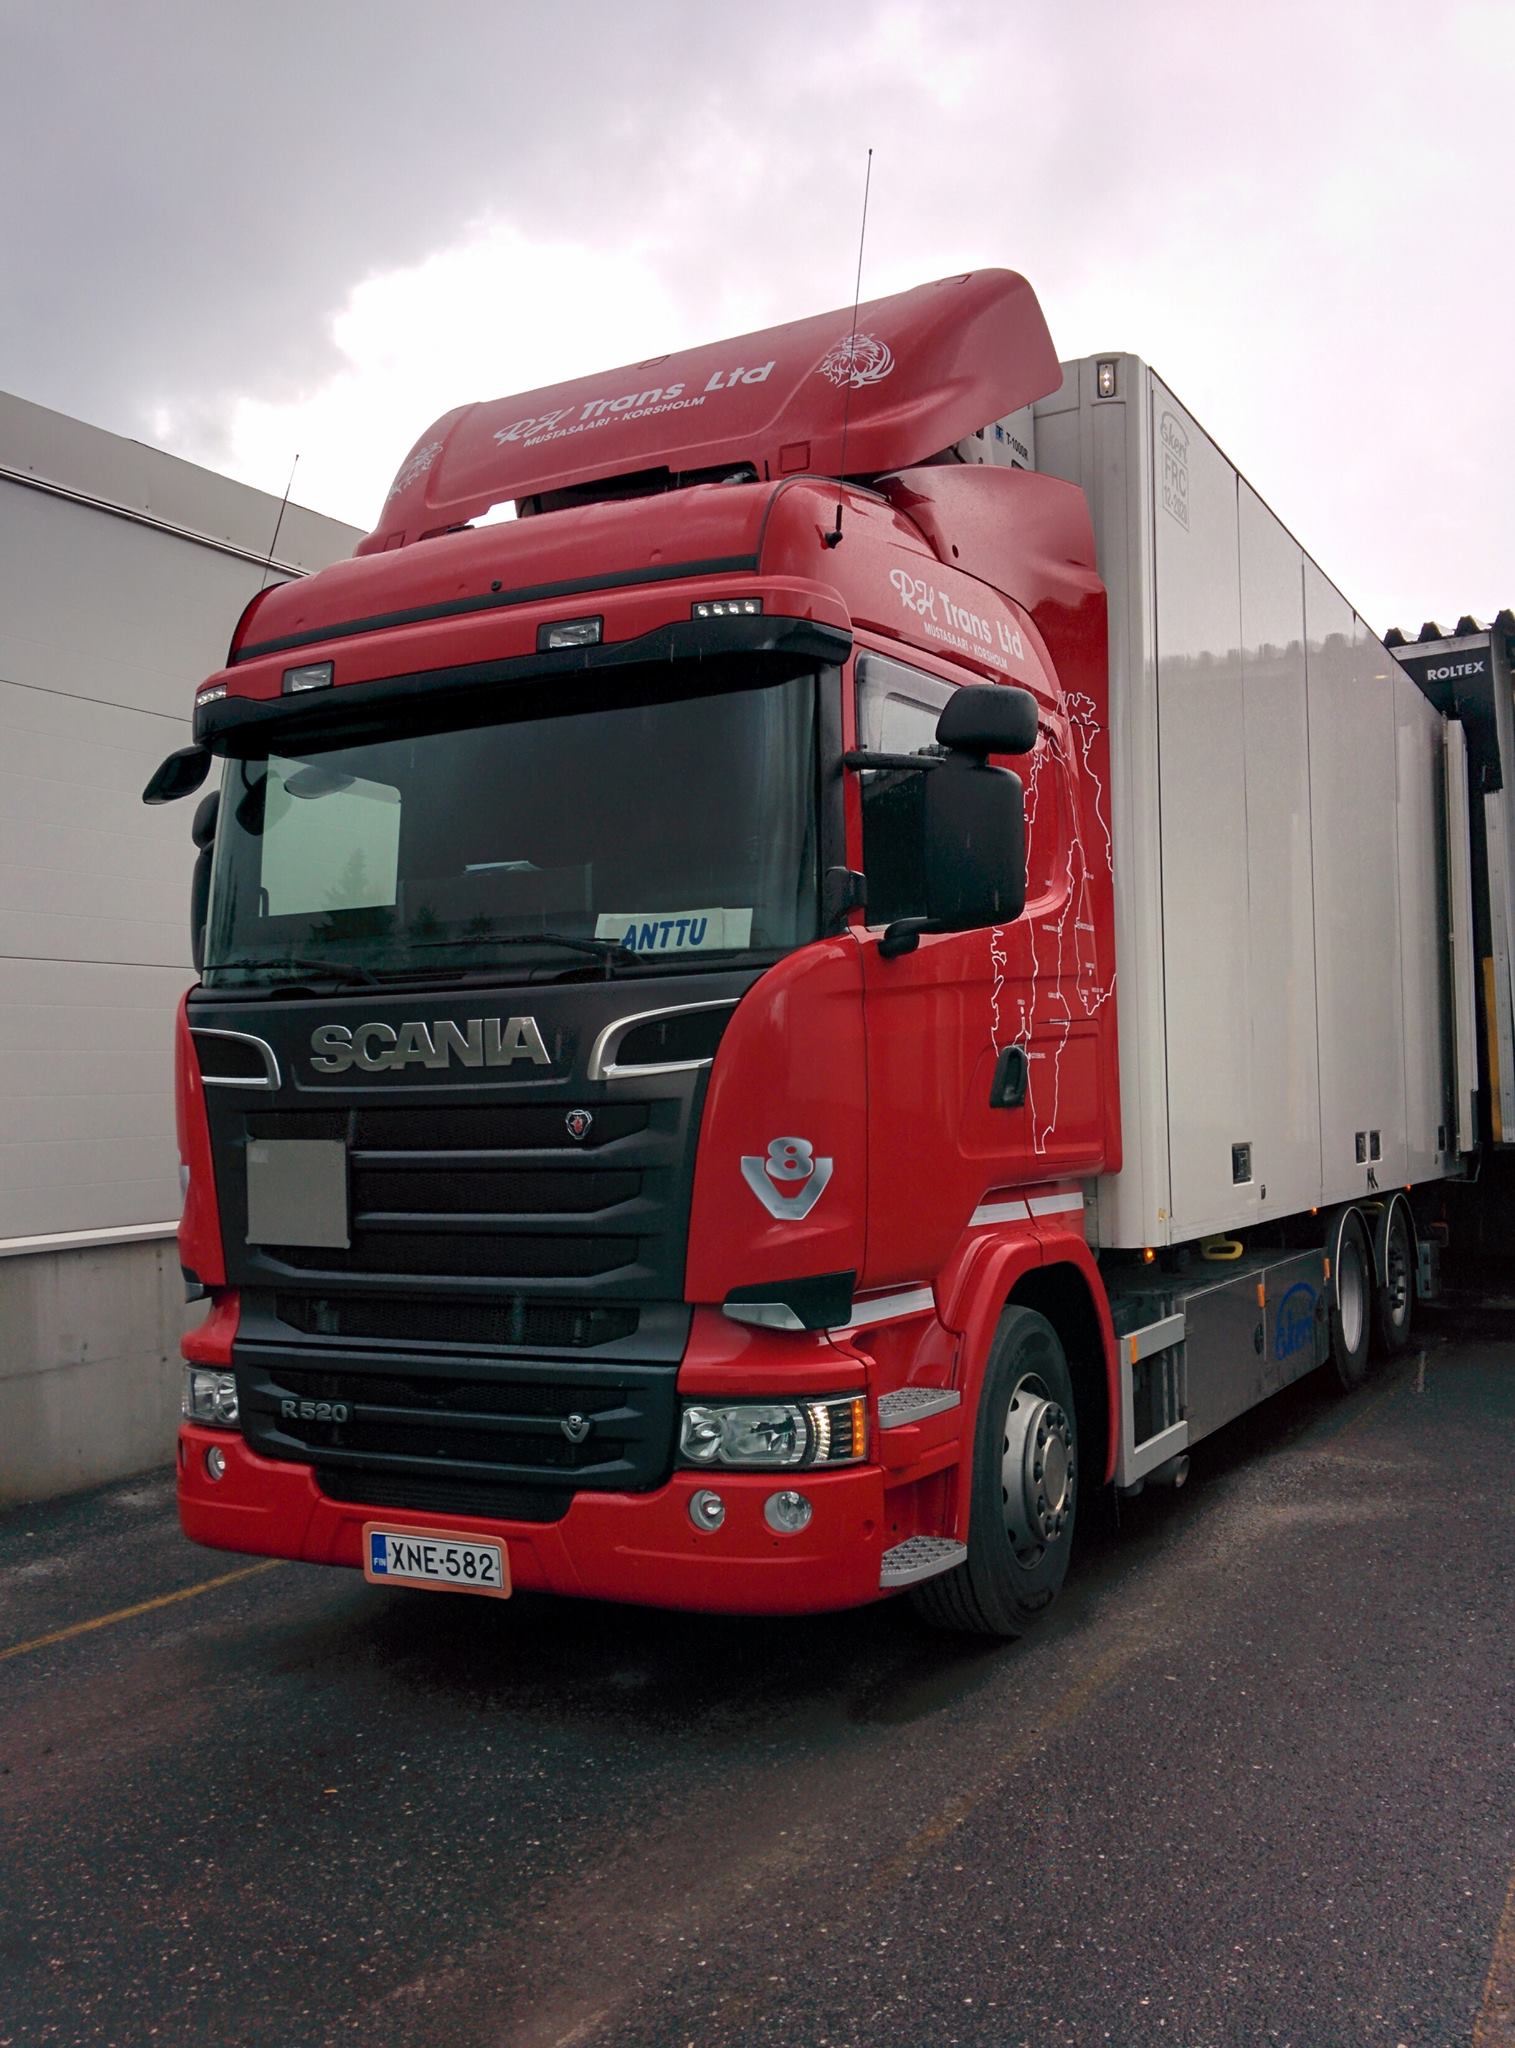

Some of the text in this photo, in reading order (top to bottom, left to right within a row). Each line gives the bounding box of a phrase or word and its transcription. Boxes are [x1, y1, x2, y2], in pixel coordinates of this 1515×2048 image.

[579, 382, 686, 421] Trans
[704, 361, 776, 392] Ltd
[523, 396, 706, 447] MUSTASAARI KORSHOLM
[1165, 452, 1187, 498] FRC
[924, 622, 1009, 669] MUSTASAARI KORSHOLM
[938, 591, 993, 644] Trans
[996, 620, 1025, 661] Ltd
[1427, 661, 1485, 681] ROLTEX
[621, 917, 708, 951] ANTTU
[310, 1016, 552, 1073] SCANIA
[391, 1541, 495, 1582] XNE-582
